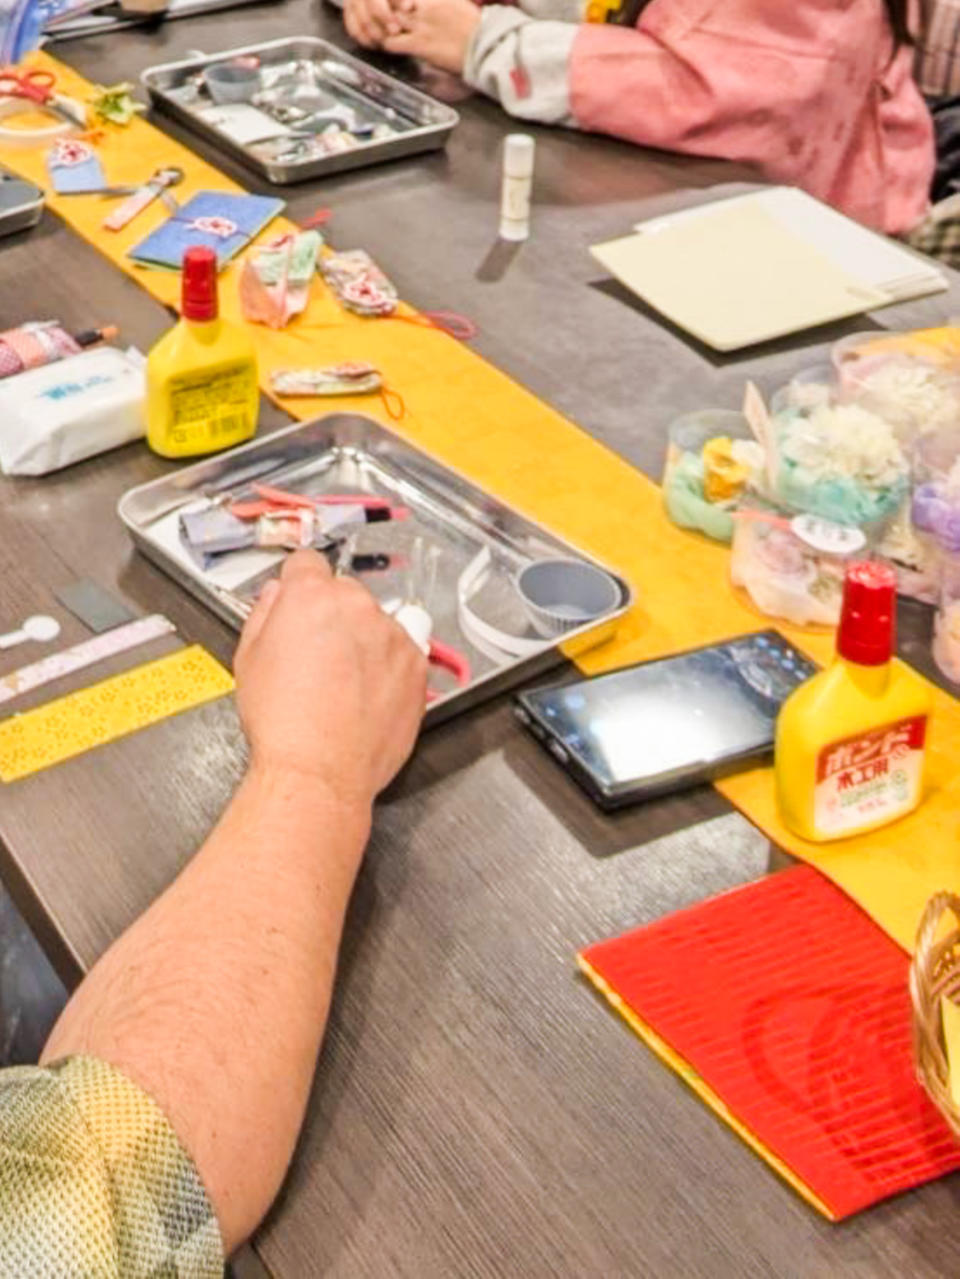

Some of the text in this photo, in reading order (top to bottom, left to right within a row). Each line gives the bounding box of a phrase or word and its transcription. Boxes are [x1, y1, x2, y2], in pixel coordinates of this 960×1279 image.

[825, 723, 913, 777] ボンド
[836, 758, 889, 793] 木工用
